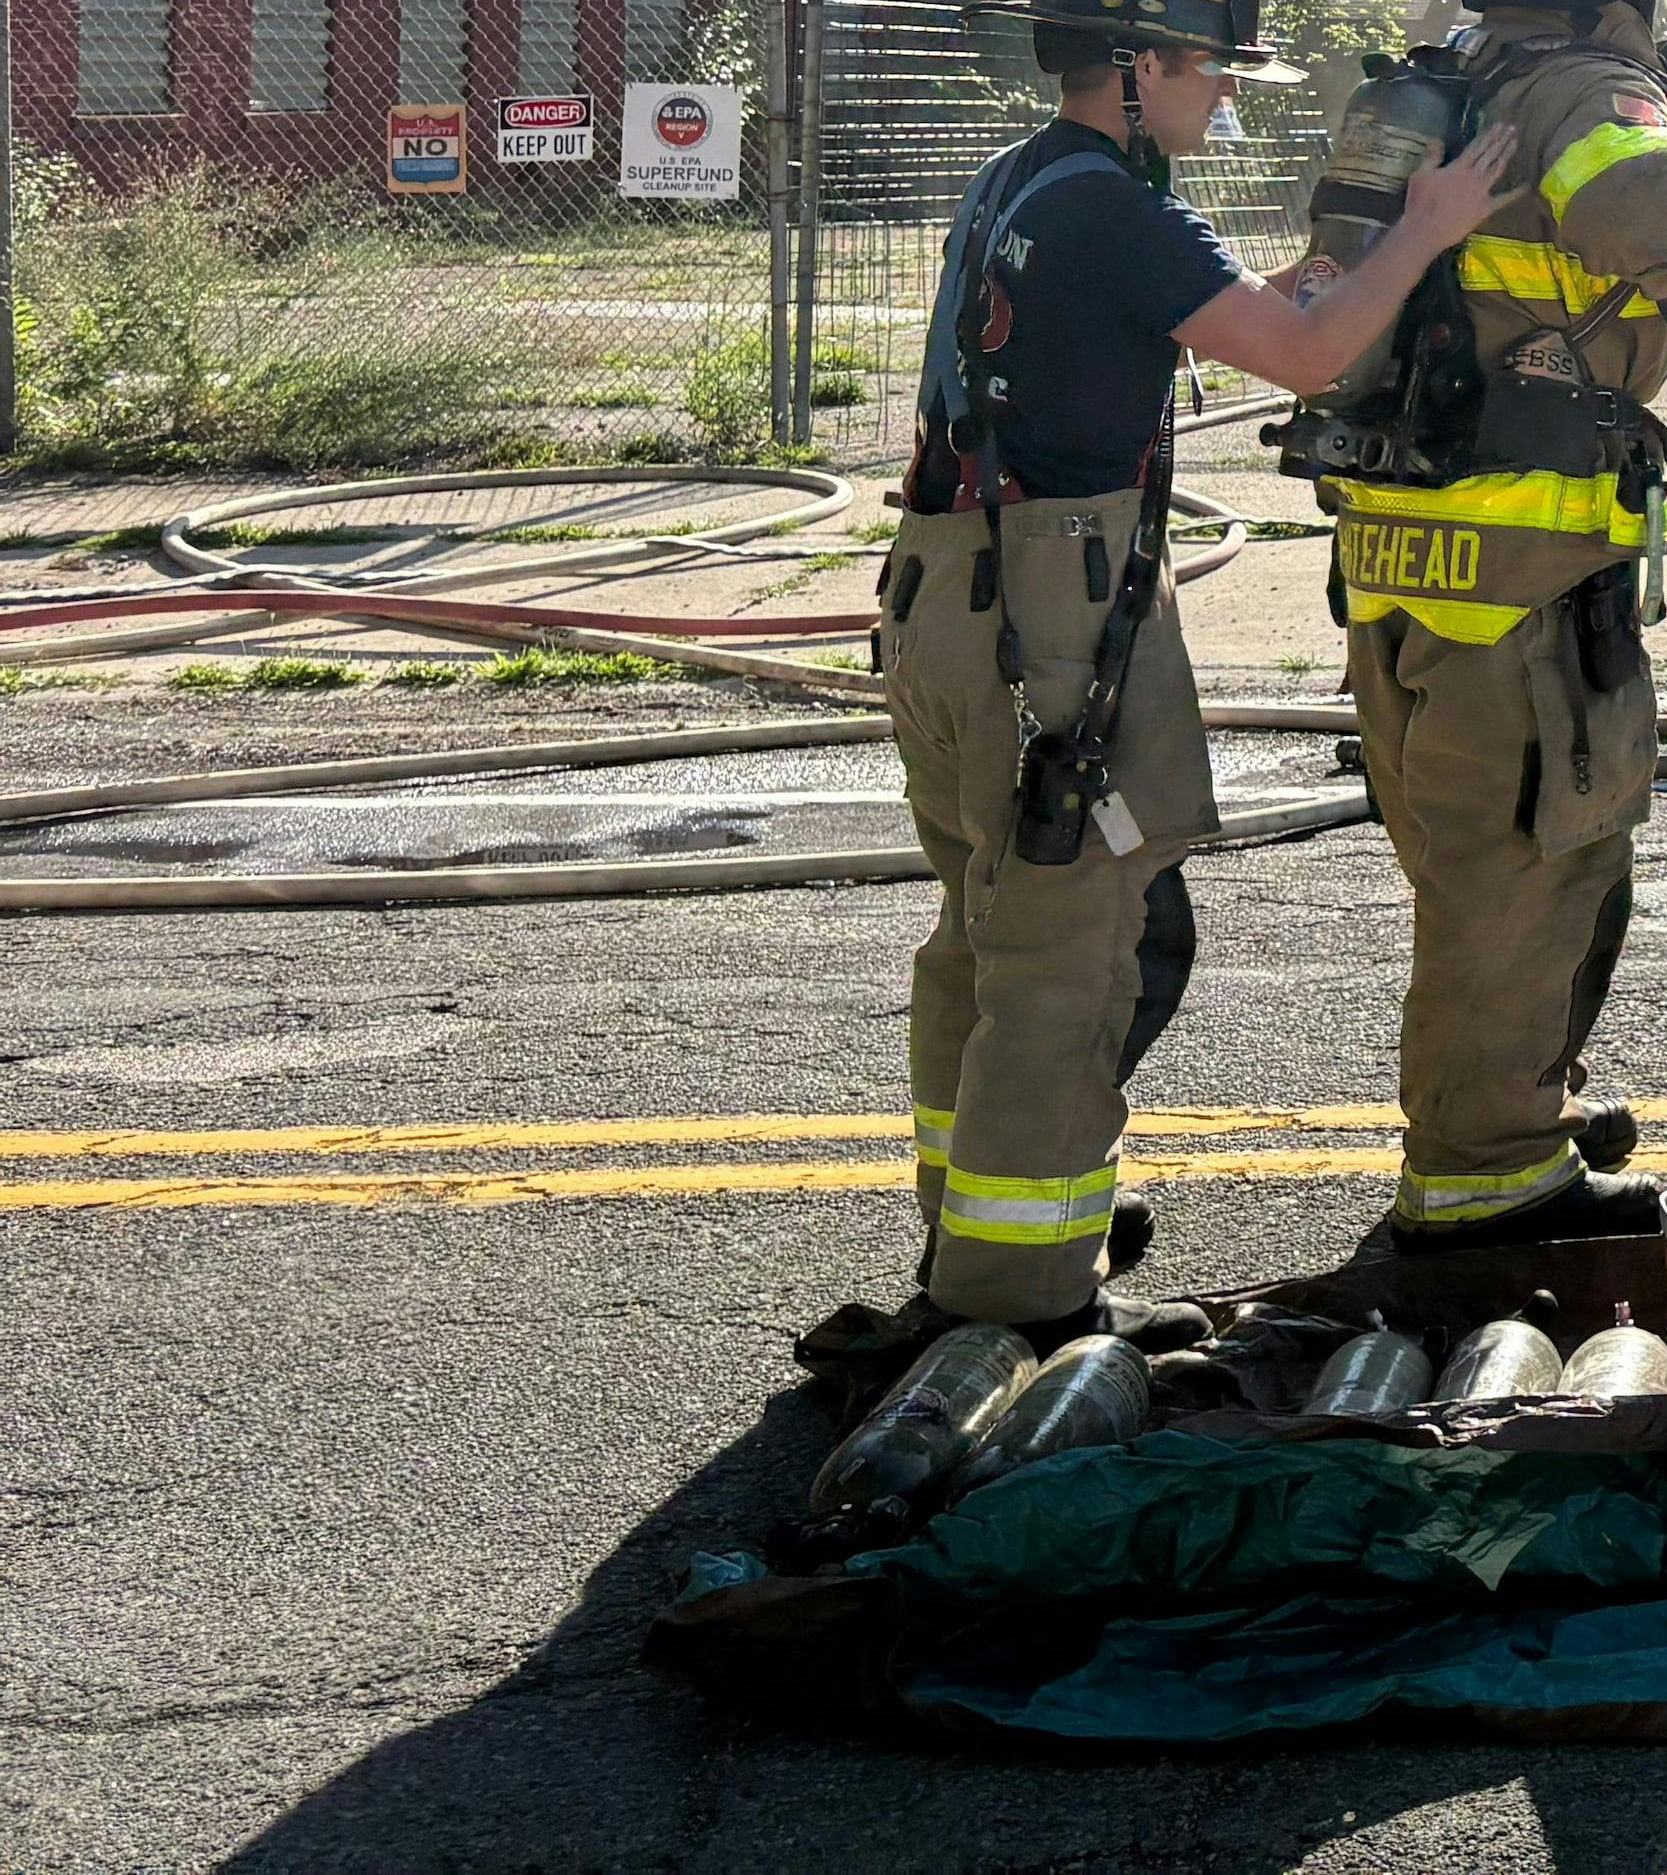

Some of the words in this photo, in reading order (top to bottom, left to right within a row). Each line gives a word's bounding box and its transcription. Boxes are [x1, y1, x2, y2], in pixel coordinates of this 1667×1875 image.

[510, 105, 580, 122] DANGER
[675, 106, 702, 119] EPA
[404, 138, 448, 157] NO
[503, 135, 547, 157] KEEP
[554, 134, 586, 155] OUT
[681, 157, 702, 166] EPA
[626, 165, 734, 182] SUPERFUND
[642, 181, 692, 191] CLEANUP
[694, 183, 717, 192] SITE
